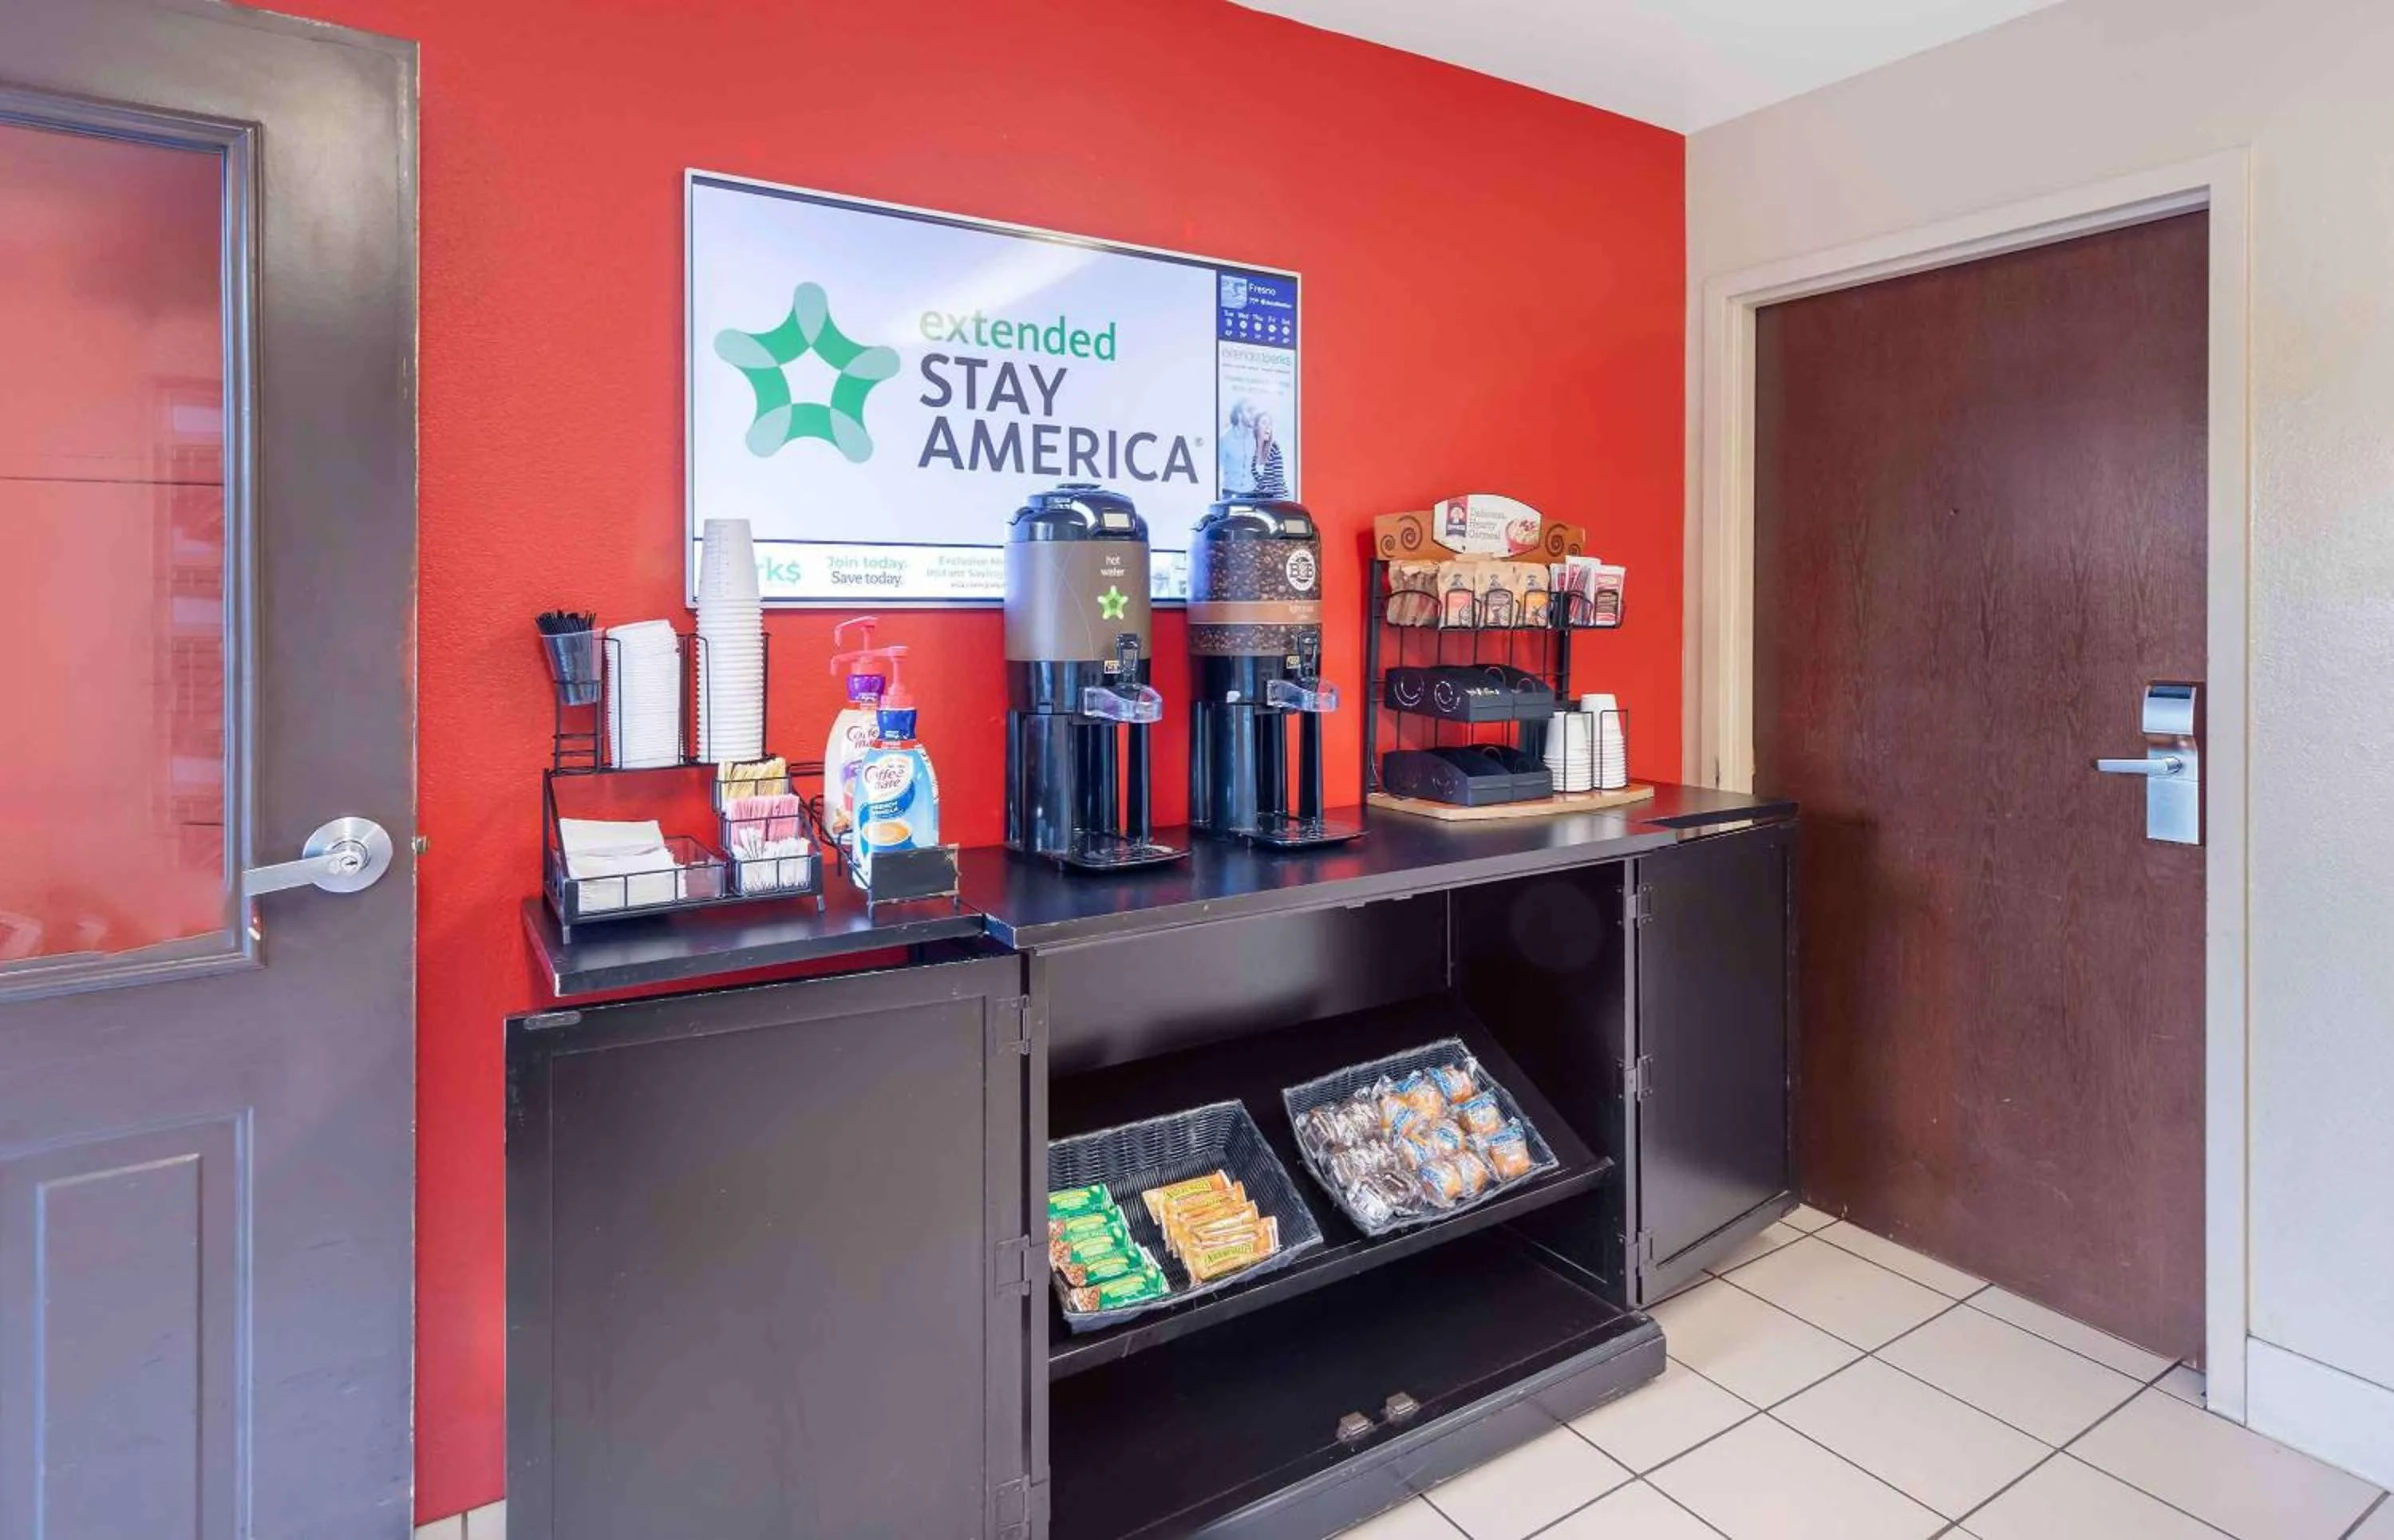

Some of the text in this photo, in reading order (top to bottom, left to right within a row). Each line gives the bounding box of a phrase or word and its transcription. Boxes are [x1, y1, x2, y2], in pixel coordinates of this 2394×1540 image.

[919, 310, 1116, 361] extended
[918, 353, 1067, 417] STAY
[918, 416, 1199, 484] AMERICA
[1100, 567, 1125, 577] water
[1105, 555, 1121, 565] hot
[831, 570, 863, 584] Save
